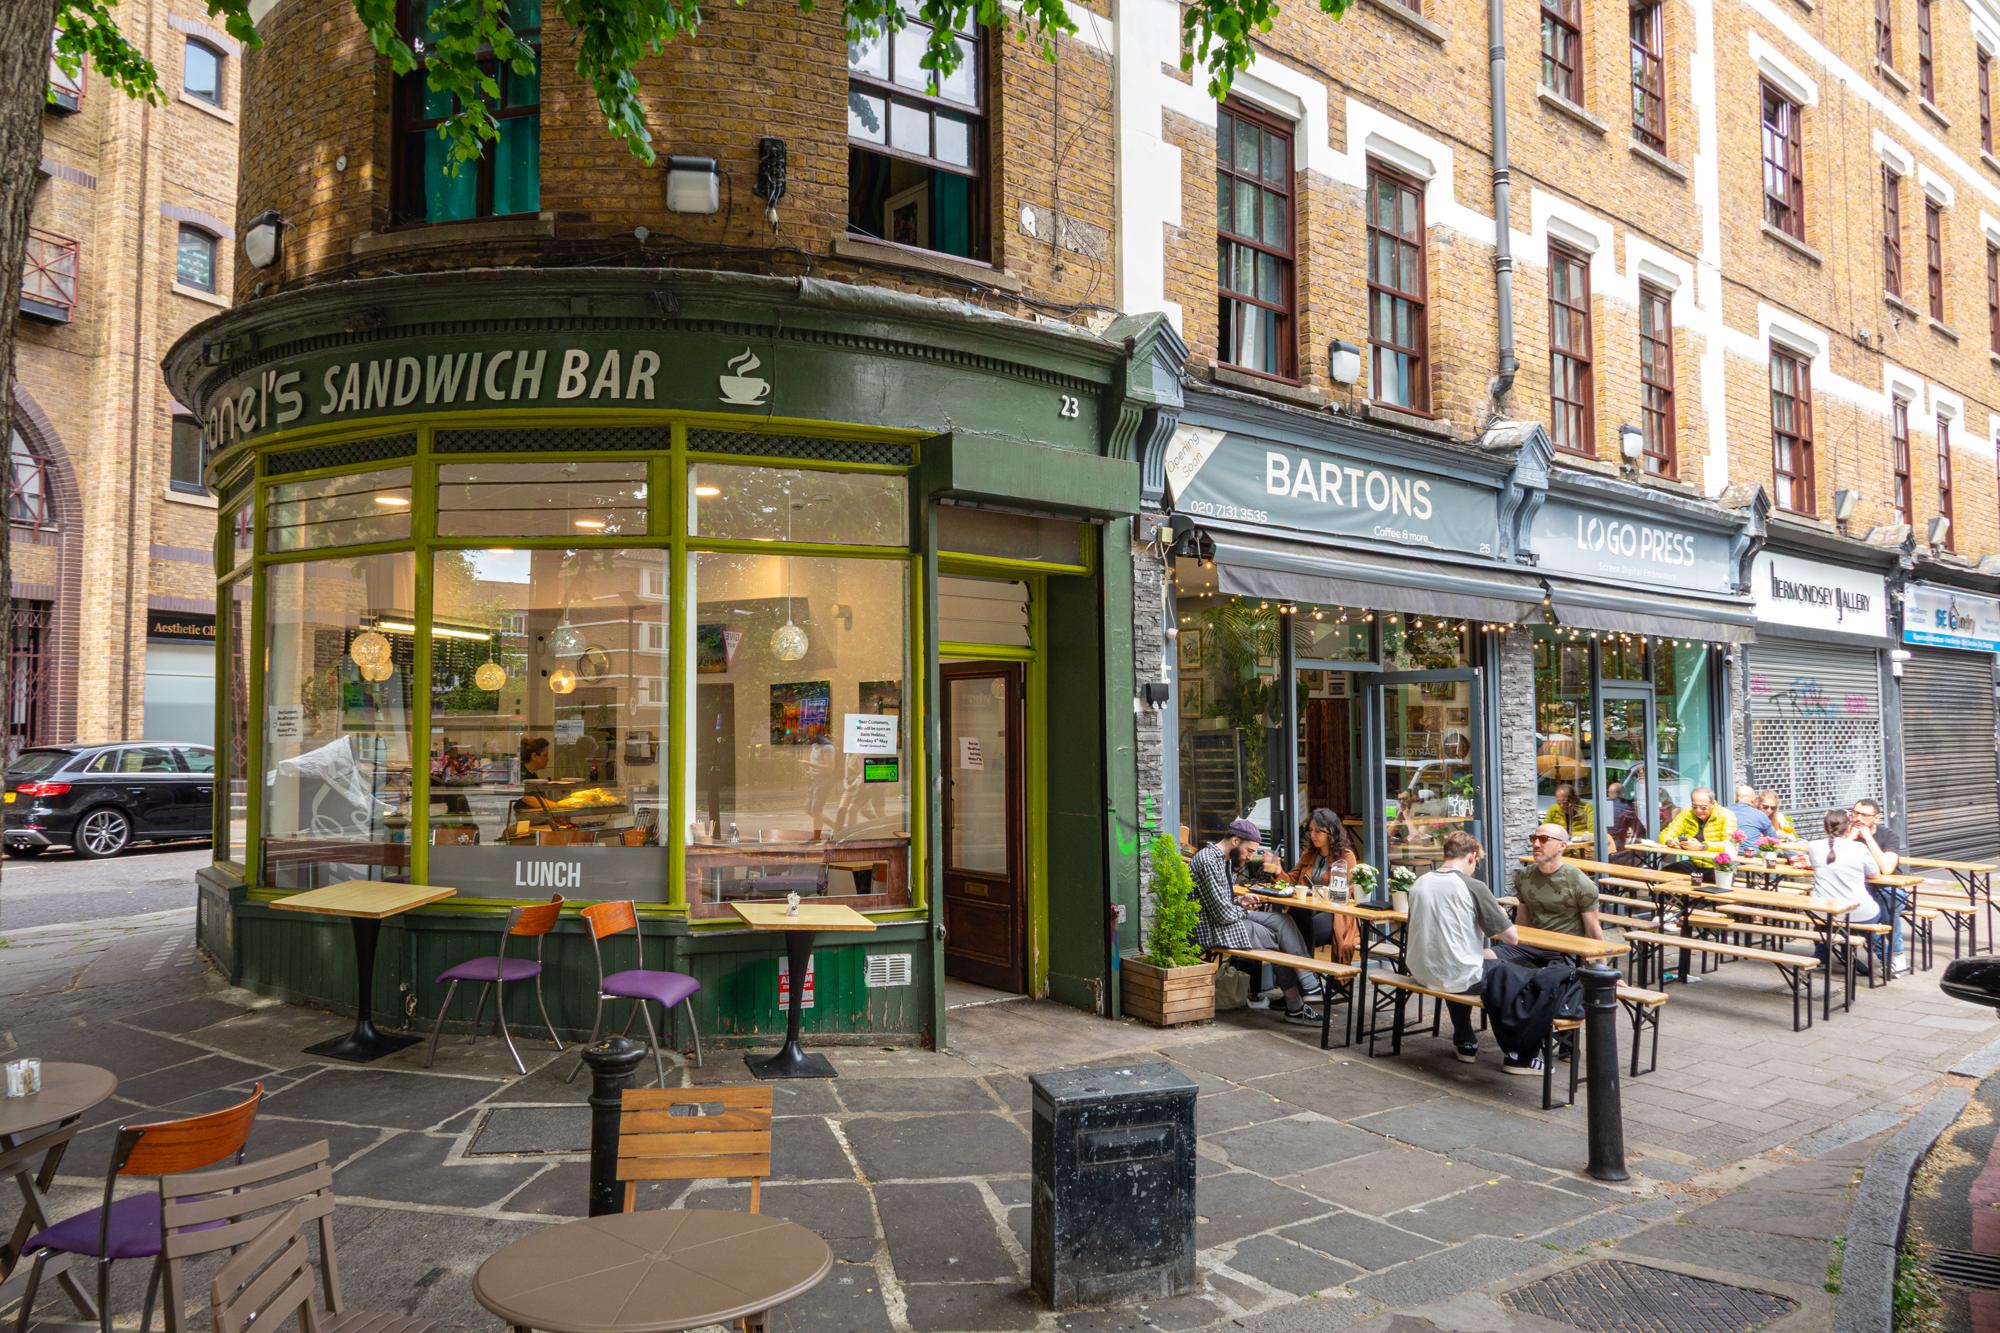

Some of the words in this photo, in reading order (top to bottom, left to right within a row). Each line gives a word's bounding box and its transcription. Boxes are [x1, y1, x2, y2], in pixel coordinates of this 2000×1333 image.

[204, 370, 302, 450] anel's
[320, 349, 547, 415] SANDWICH
[556, 349, 661, 400] BAR
[1060, 394, 1080, 418] 23
[1167, 432, 1200, 473] Opening
[1182, 452, 1204, 478] Soon
[1266, 451, 1433, 521] BARTONS
[1190, 500, 1214, 515] 020
[1216, 504, 1238, 518] 7131
[1239, 507, 1268, 523] 3535
[1374, 525, 1401, 539] Coffee
[1402, 529, 1409, 539] &
[1577, 514, 1637, 557] LOGO
[1640, 526, 1696, 568] PRESS
[154, 622, 201, 635] Aesthetic
[1936, 608, 1948, 628] SE
[515, 860, 581, 888] LUNCH
